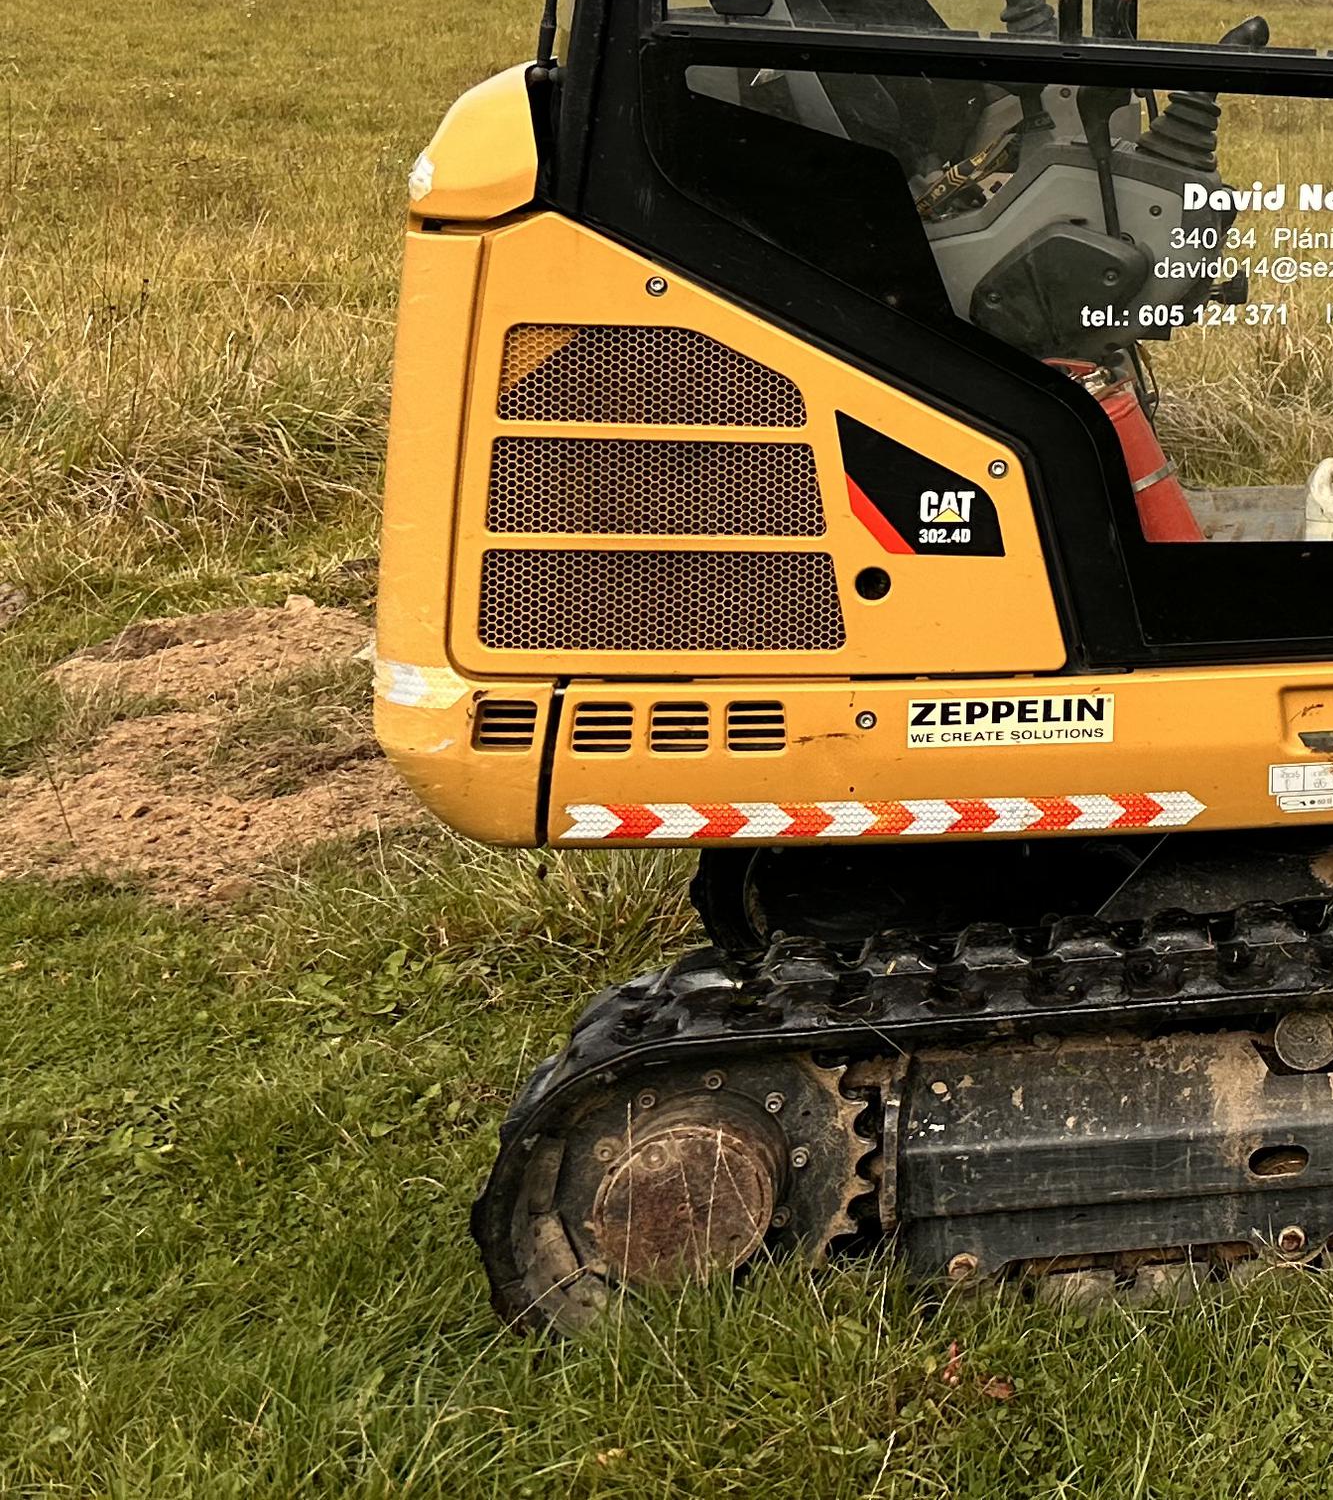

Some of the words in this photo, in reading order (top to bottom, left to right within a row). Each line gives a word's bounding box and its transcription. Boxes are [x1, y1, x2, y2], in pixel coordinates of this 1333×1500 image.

[1183, 181, 1286, 211] David
[1170, 227, 1218, 249] 340
[1226, 227, 1257, 249] 34
[1081, 305, 1130, 328] tel.:
[1138, 304, 1184, 327] 605
[1193, 304, 1237, 326] 124
[1245, 304, 1288, 326] 371
[919, 490, 976, 523] CAT
[918, 528, 971, 544] 302.4D
[911, 698, 1105, 727] ZEPPELIN
[911, 733, 935, 743] WE
[940, 731, 1005, 743] CREATE
[1010, 728, 1104, 741] SOLUTIONS
